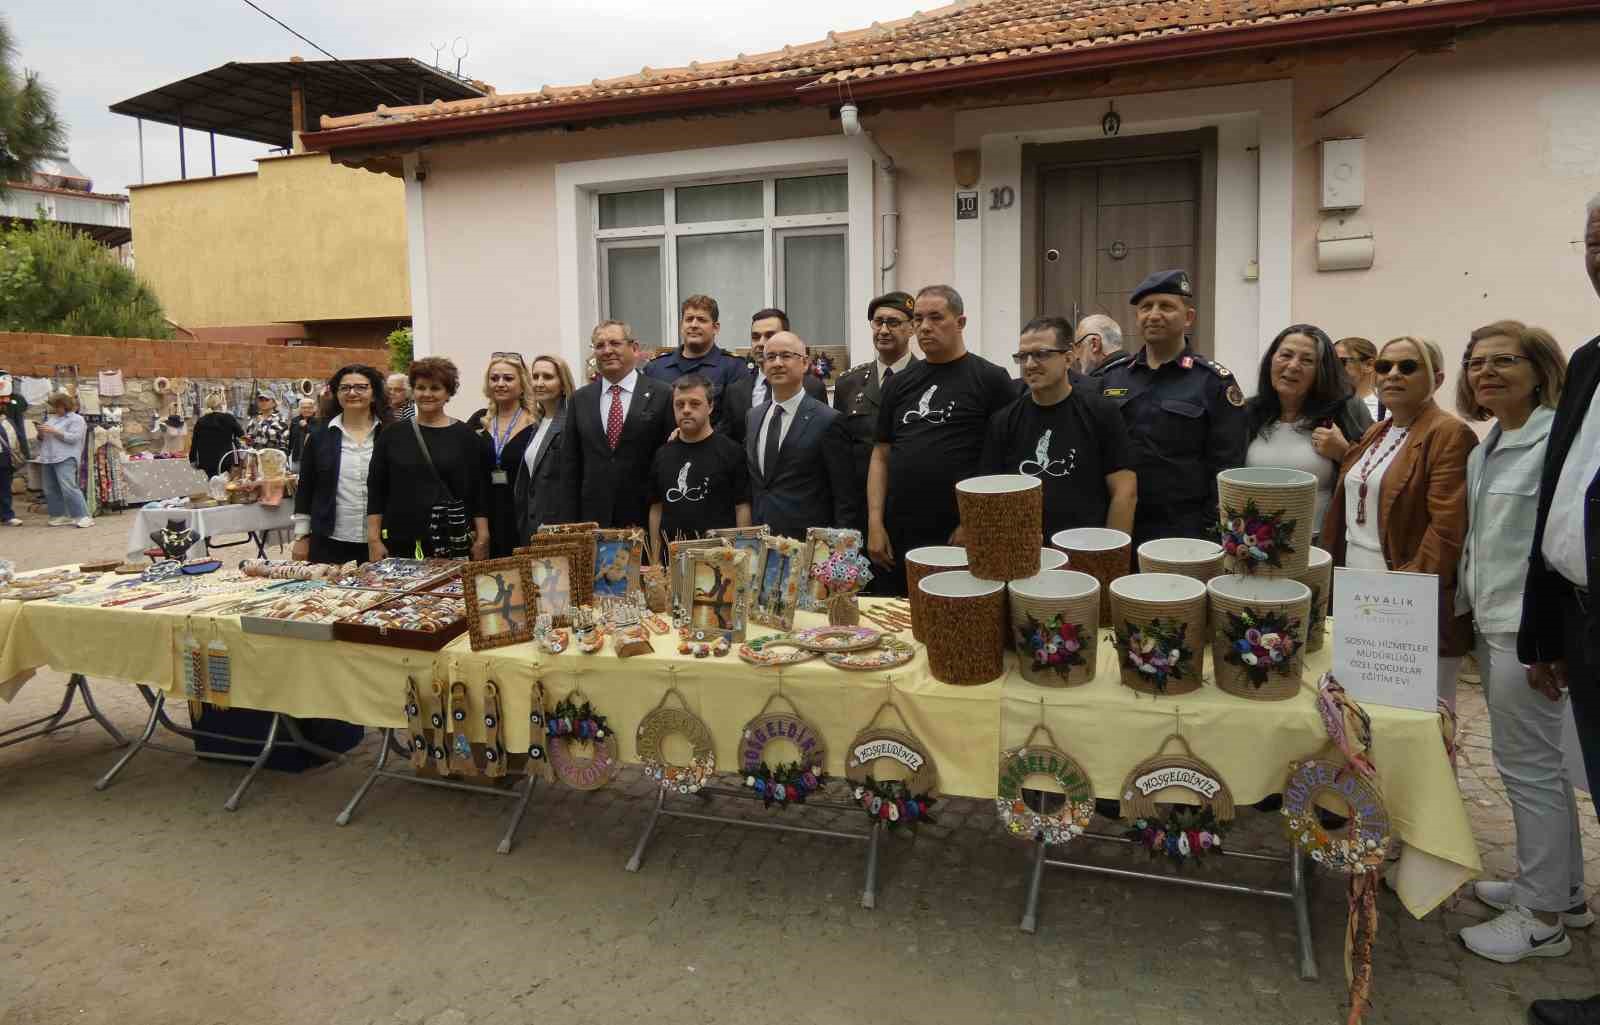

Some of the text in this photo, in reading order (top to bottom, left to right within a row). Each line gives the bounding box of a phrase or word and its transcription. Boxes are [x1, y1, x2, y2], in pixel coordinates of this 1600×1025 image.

[960, 198, 974, 210] 10
[990, 186, 1015, 210] 10
[1354, 593, 1414, 607] AYVALIK
[1345, 637, 1377, 648] SOSYAL
